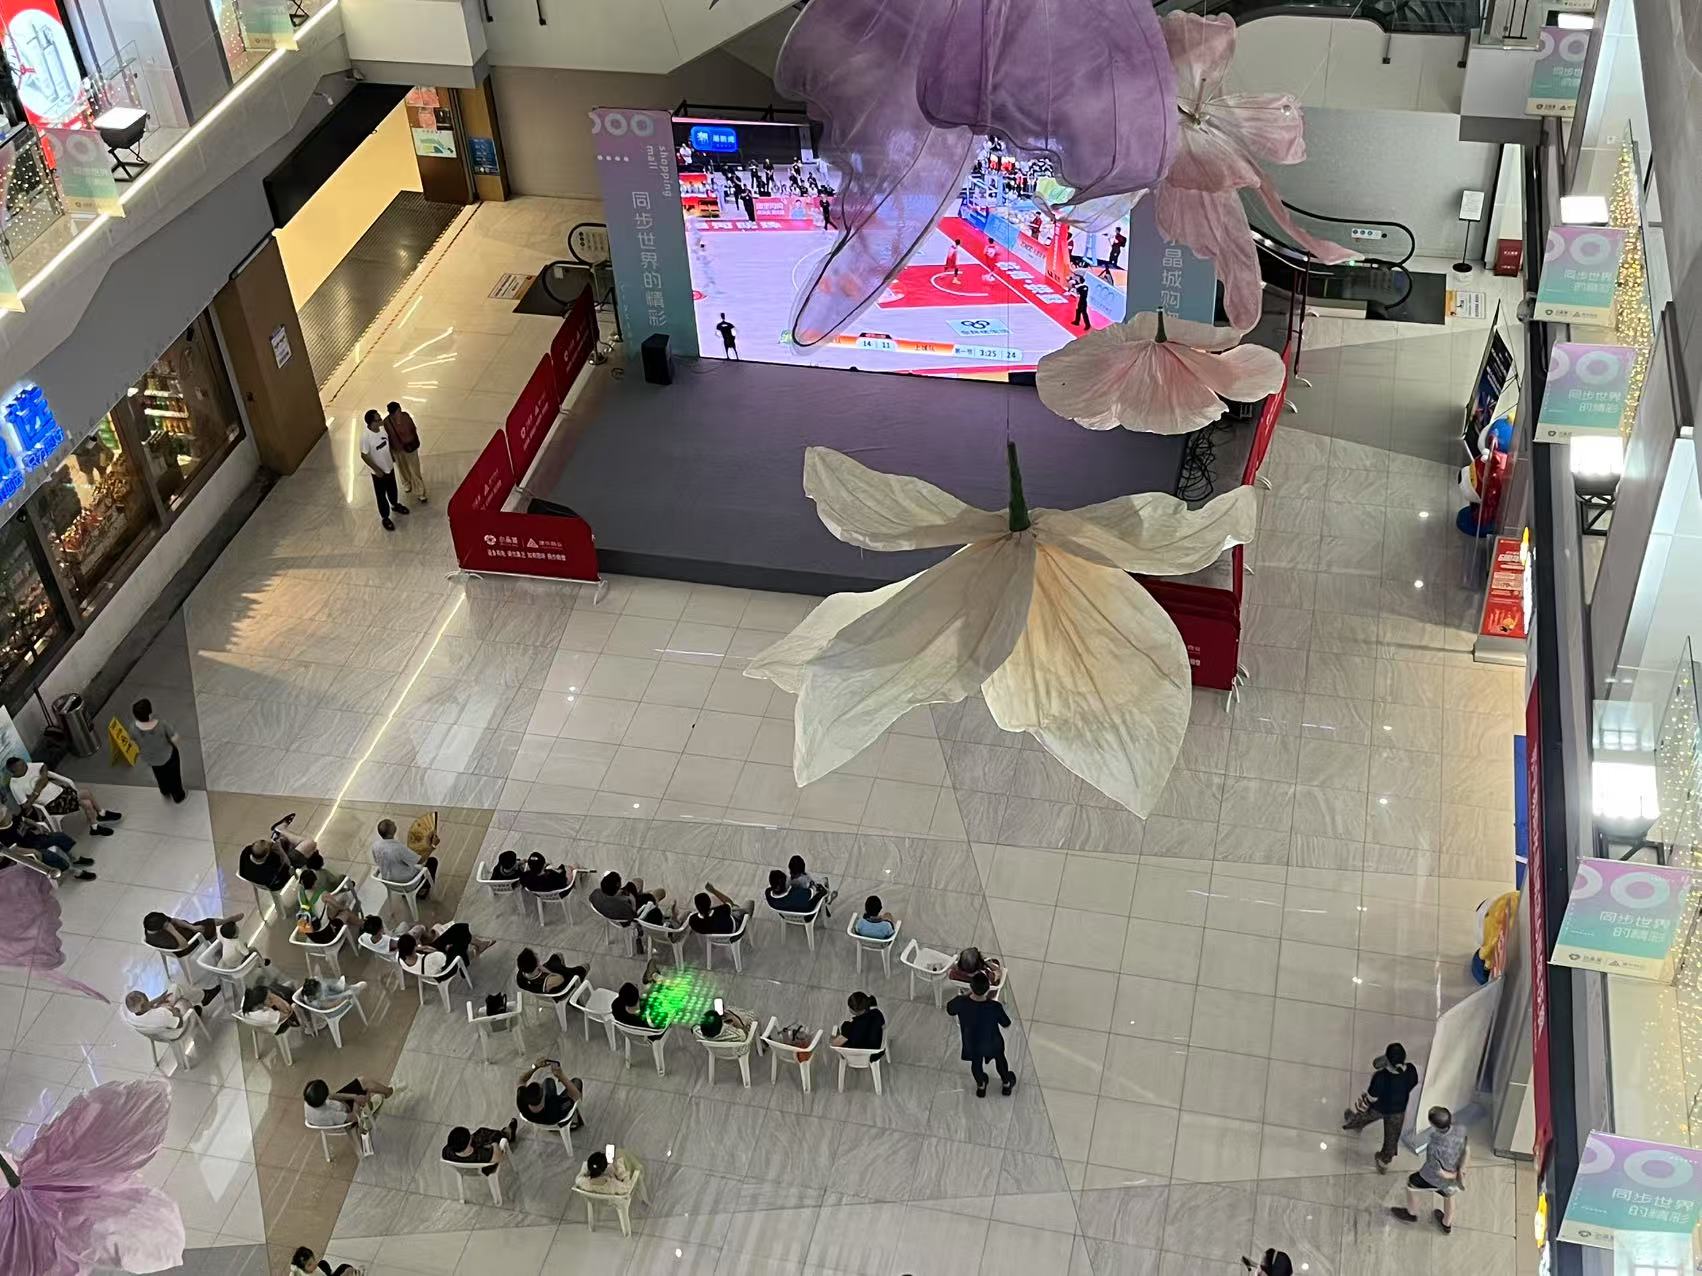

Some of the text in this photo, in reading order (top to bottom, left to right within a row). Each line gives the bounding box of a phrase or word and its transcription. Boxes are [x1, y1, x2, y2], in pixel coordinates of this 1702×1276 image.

[646, 145, 658, 170] mall
[658, 145, 672, 197] shopping
[1161, 240, 1183, 318] 晶城购
[979, 349, 997, 358] 3:25
[1006, 351, 1017, 359] 24
[1600, 911, 1670, 930] 同步世界
[1612, 1187, 1695, 1212] 同步世界
